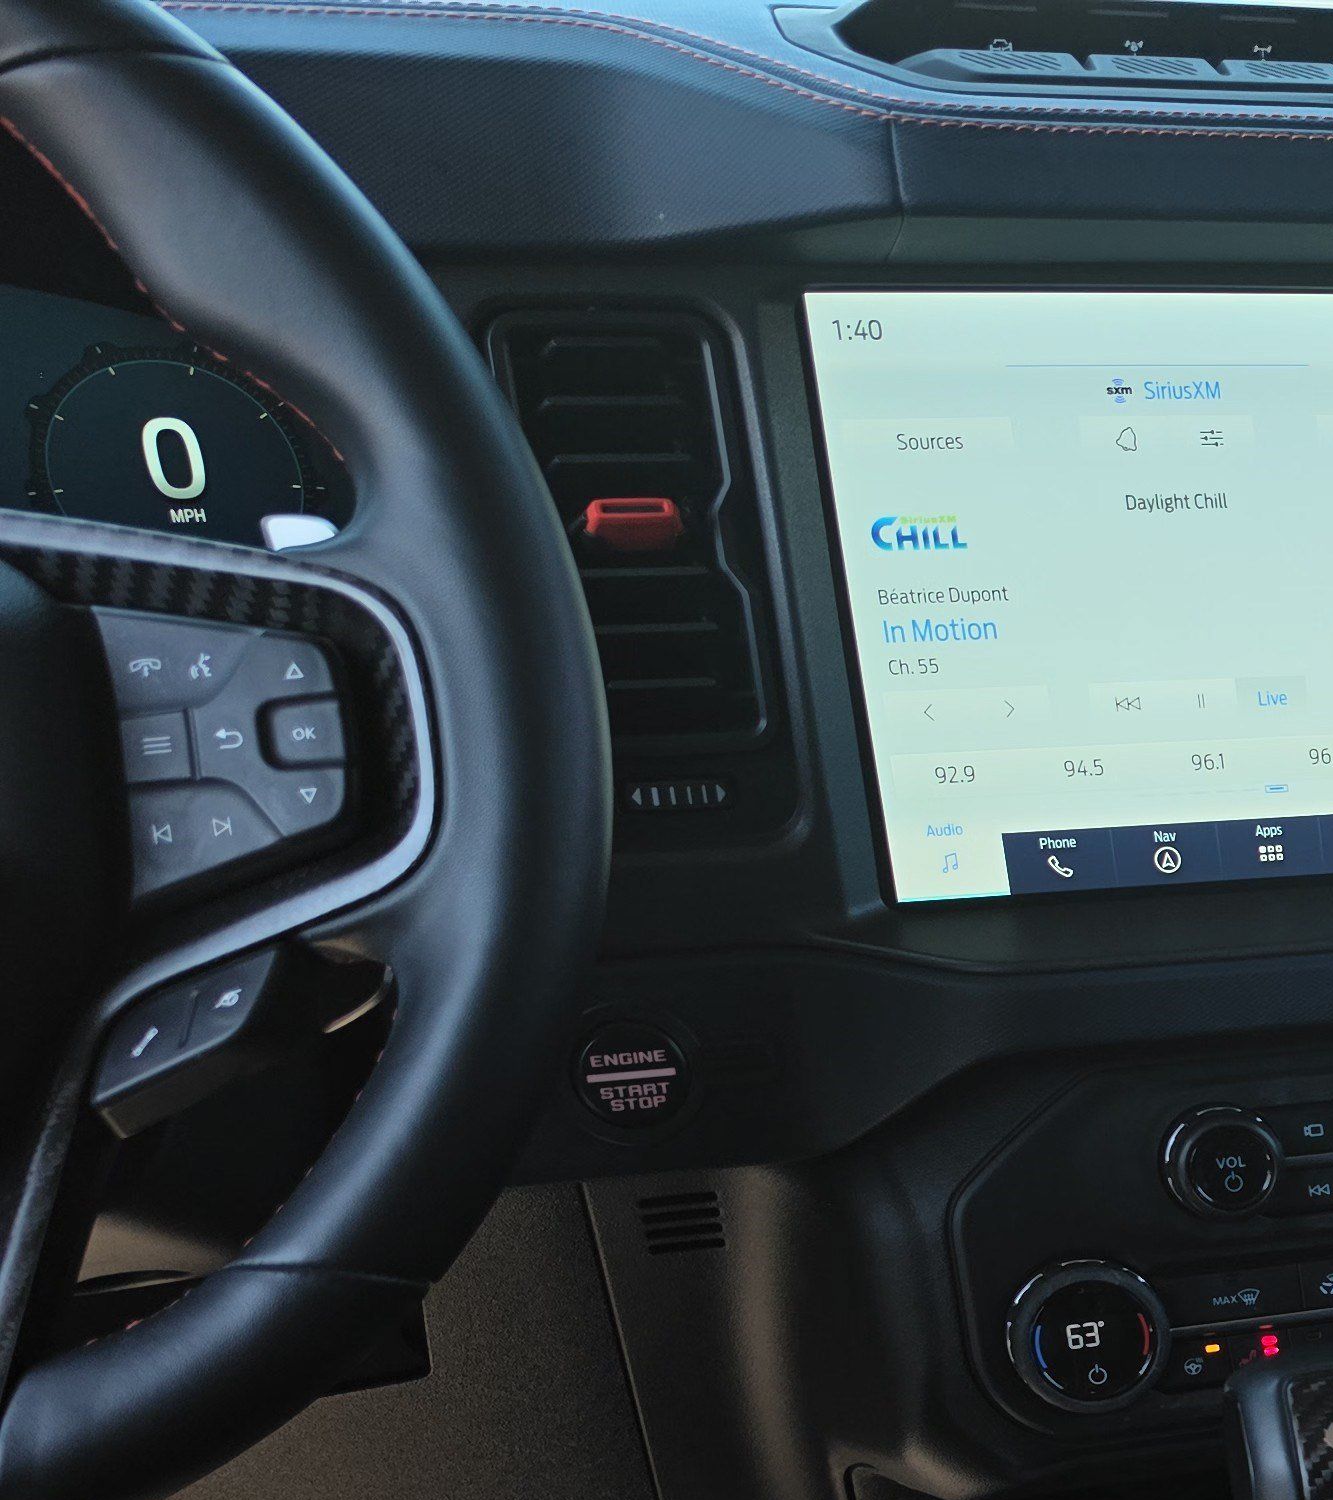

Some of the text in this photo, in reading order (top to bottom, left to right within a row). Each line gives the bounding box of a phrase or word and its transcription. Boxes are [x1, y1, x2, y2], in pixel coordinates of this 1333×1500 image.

[832, 319, 883, 341] 1:40
[1143, 381, 1222, 401] SiriusXM
[896, 432, 964, 451] Sources
[142, 416, 206, 500] 0
[1124, 491, 1228, 513] Daylight Chill
[169, 508, 207, 524] MPH
[871, 516, 968, 551] CHILL
[877, 584, 1009, 607] Béatrice Dupont
[882, 616, 998, 643] In Motion
[888, 657, 940, 676] Ch. 55
[1257, 689, 1288, 707] Live
[291, 726, 316, 741] OK
[1063, 758, 1105, 778] 94.5
[1191, 752, 1226, 772] 96.1
[934, 765, 976, 785] 92.9
[926, 823, 964, 839] Audio
[1154, 829, 1177, 843] Nav
[1255, 824, 1283, 839] Apps
[1039, 835, 1077, 850] Phone
[589, 1049, 667, 1068] ENGINE
[600, 1082, 670, 1100] START
[610, 1095, 667, 1112] STOP
[1215, 1156, 1247, 1170] VOL
[1211, 1295, 1238, 1306] MAX
[1066, 1320, 1105, 1350] 63°
